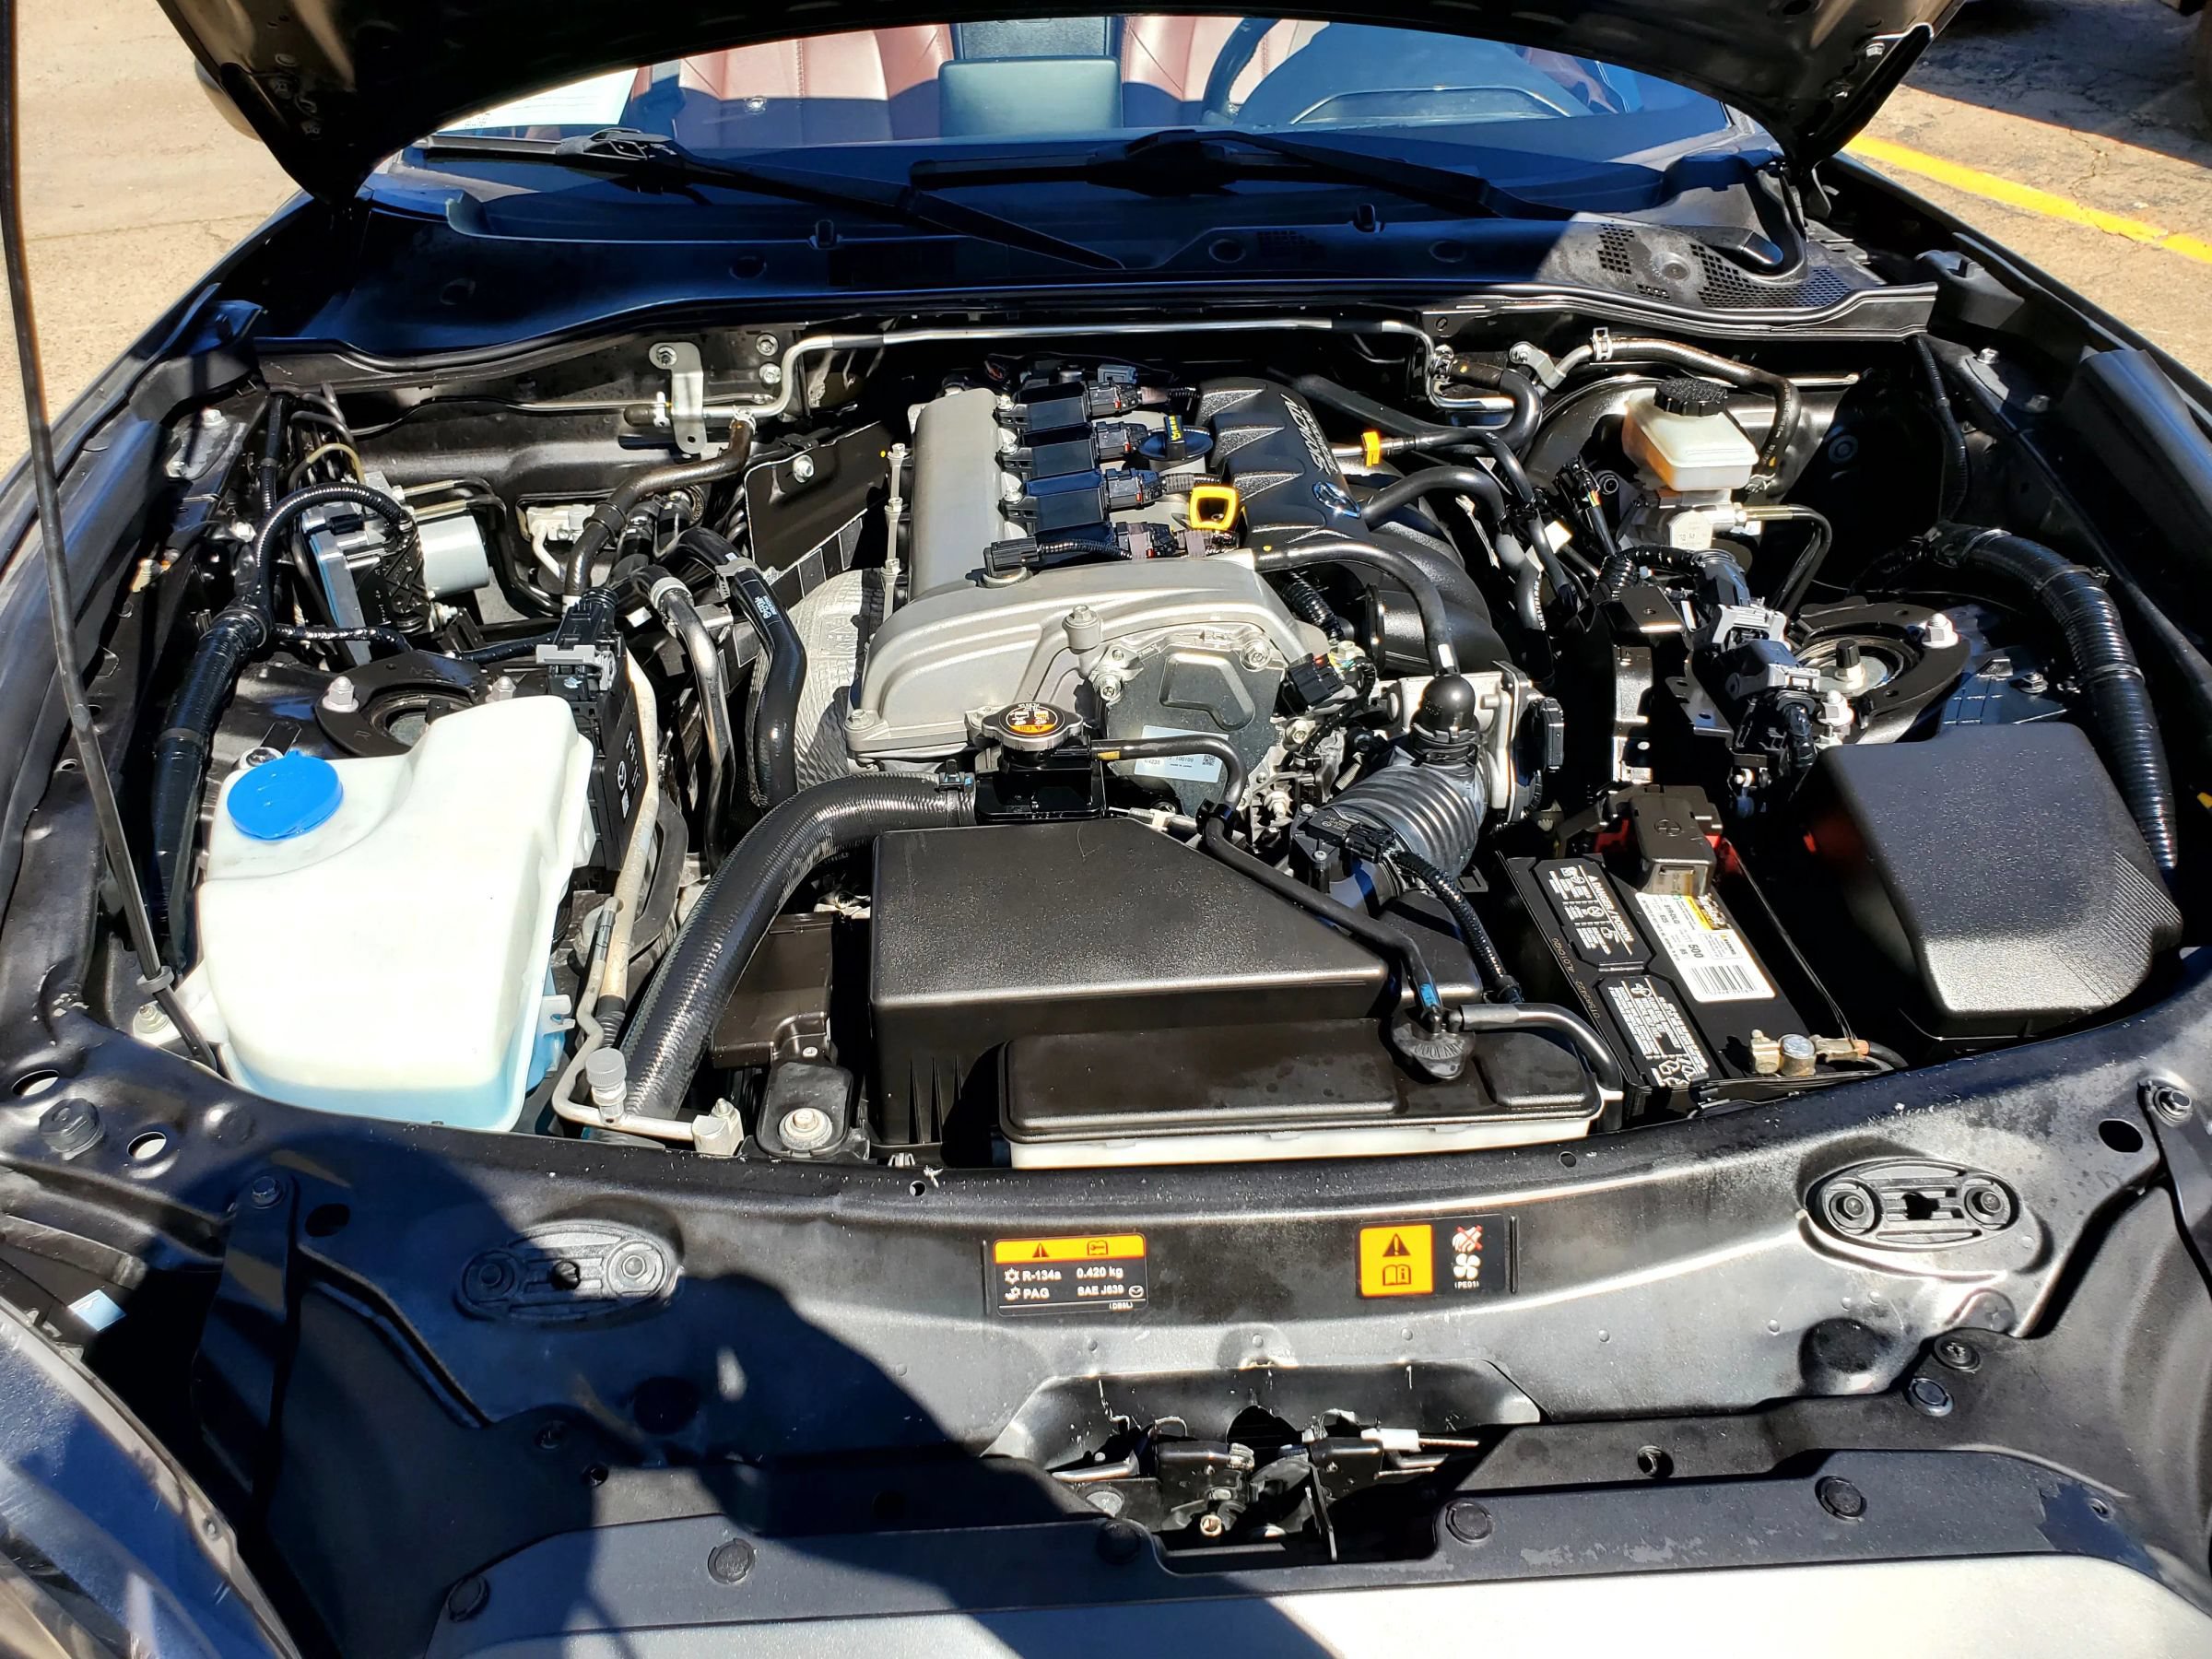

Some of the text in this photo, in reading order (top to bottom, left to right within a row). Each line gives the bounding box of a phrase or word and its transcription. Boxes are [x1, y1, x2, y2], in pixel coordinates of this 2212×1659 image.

[1591, 881, 1615, 911] DANGER
[1611, 914, 1635, 942] POISON
[1688, 944, 1704, 959] 500
[1022, 1269, 1062, 1282] R-134a
[1077, 1265, 1124, 1279] 0.420 kg
[1023, 1287, 1050, 1300] PAG
[1077, 1285, 1100, 1297] SAE
